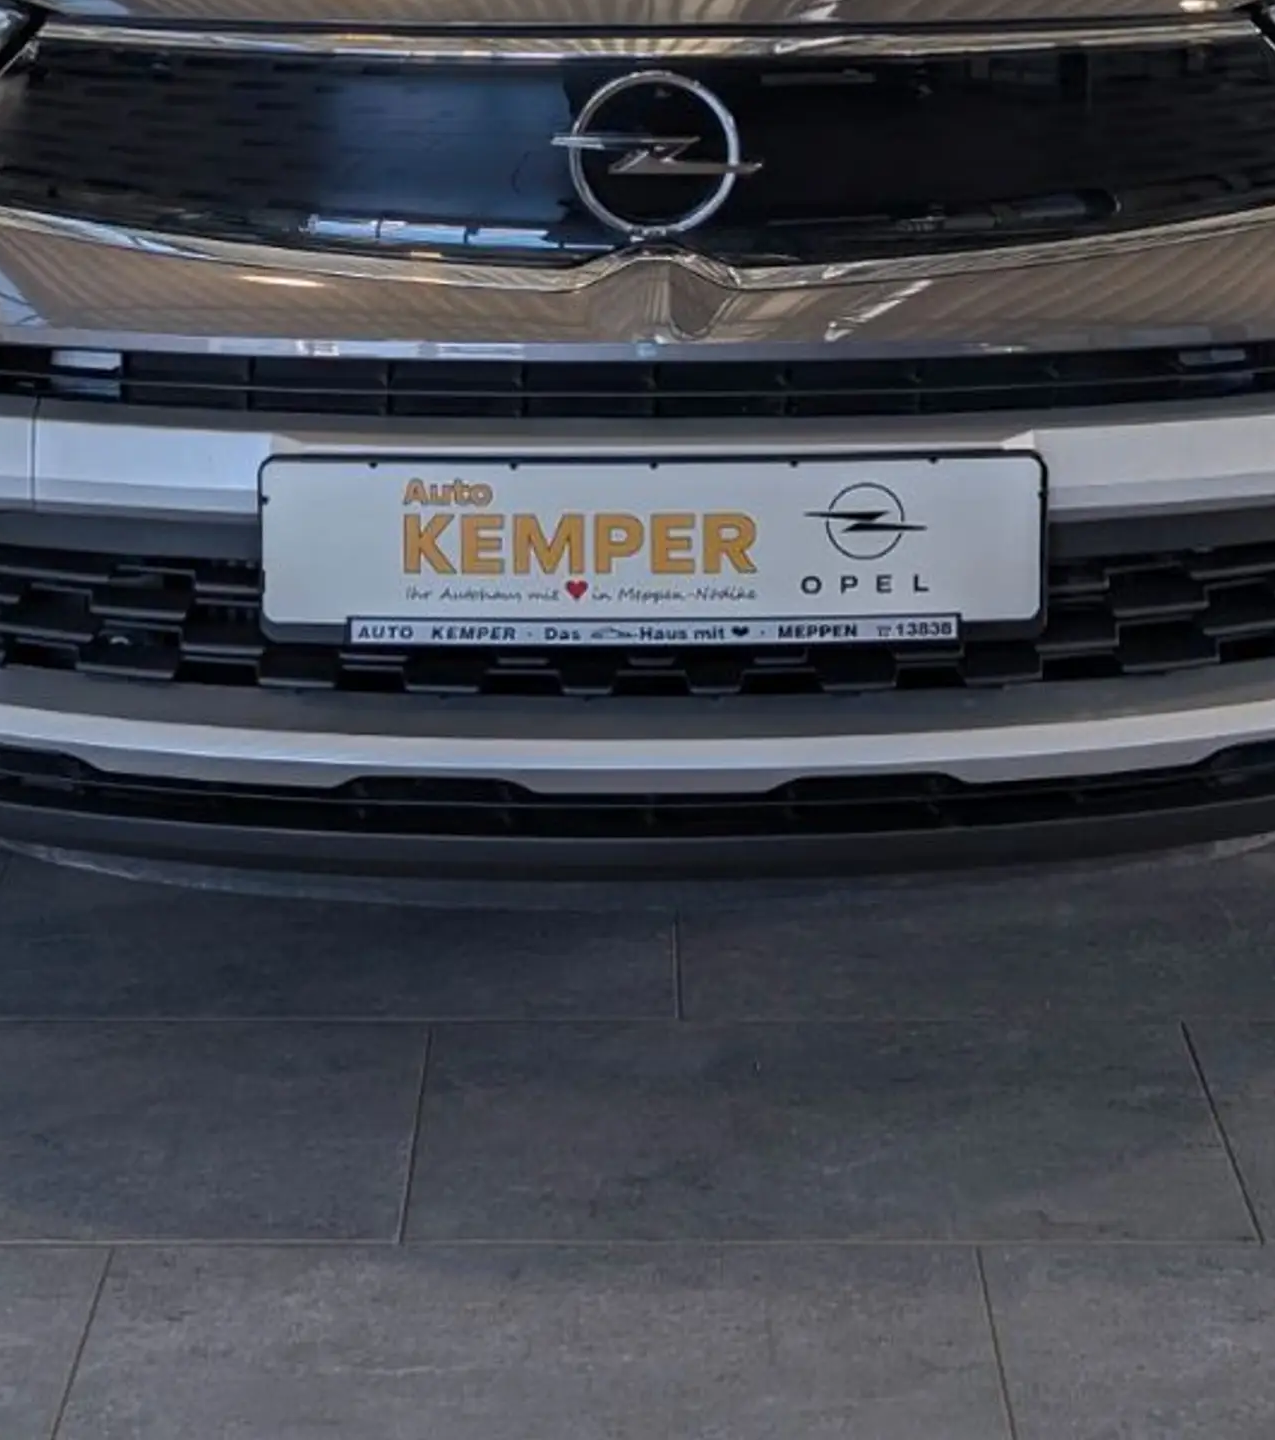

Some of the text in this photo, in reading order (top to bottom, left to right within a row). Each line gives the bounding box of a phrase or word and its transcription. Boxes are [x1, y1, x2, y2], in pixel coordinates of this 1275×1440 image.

[403, 477, 493, 506] Auto
[403, 513, 758, 574] KEMPER
[528, 587, 560, 601] mit
[800, 574, 929, 594] OPEL
[358, 625, 413, 640] AUTO
[431, 625, 516, 641] KEMPER
[544, 626, 581, 640] Das
[639, 626, 688, 640] Haus
[693, 625, 725, 640] mit
[778, 624, 857, 639] MEPPEN
